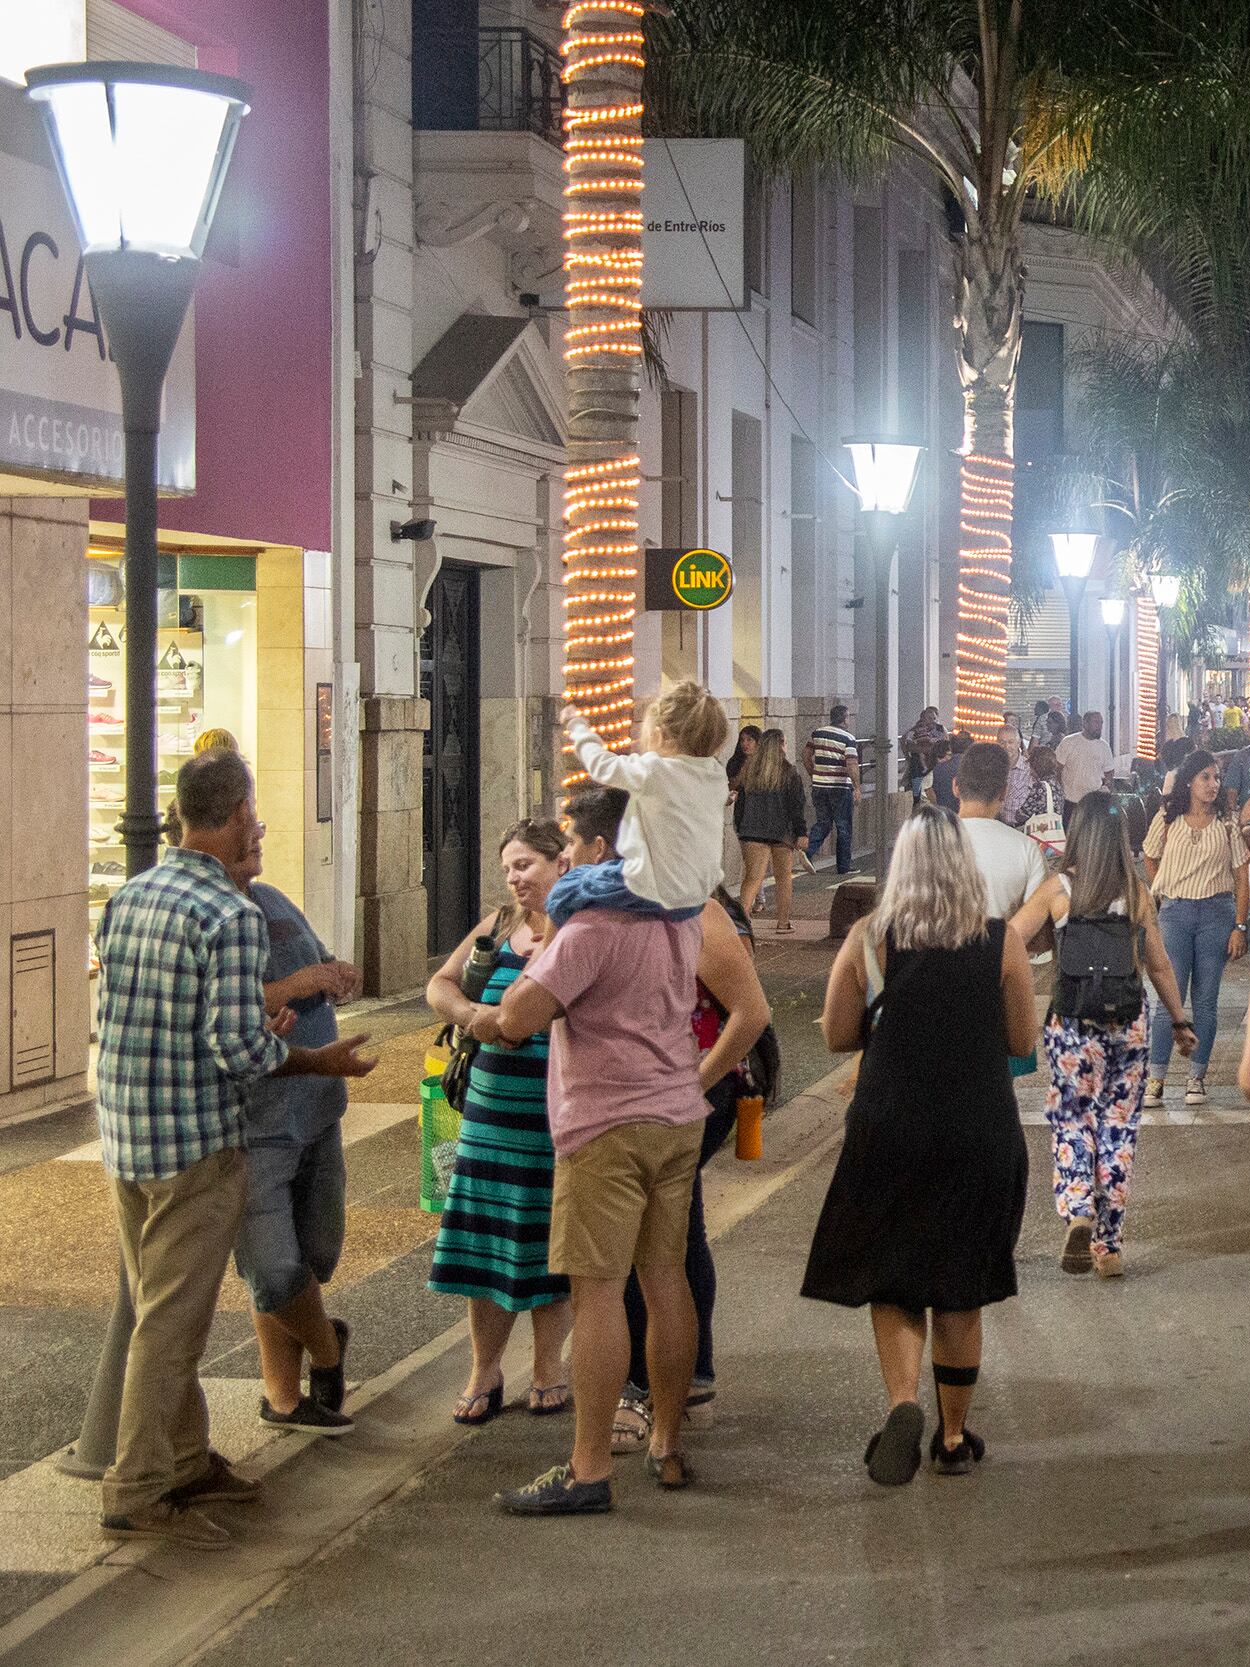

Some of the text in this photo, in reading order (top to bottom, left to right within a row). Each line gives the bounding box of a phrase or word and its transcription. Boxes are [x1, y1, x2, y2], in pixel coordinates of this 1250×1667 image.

[647, 220, 726, 232] de Entre Ríos
[9, 412, 126, 464] ACCESORIO
